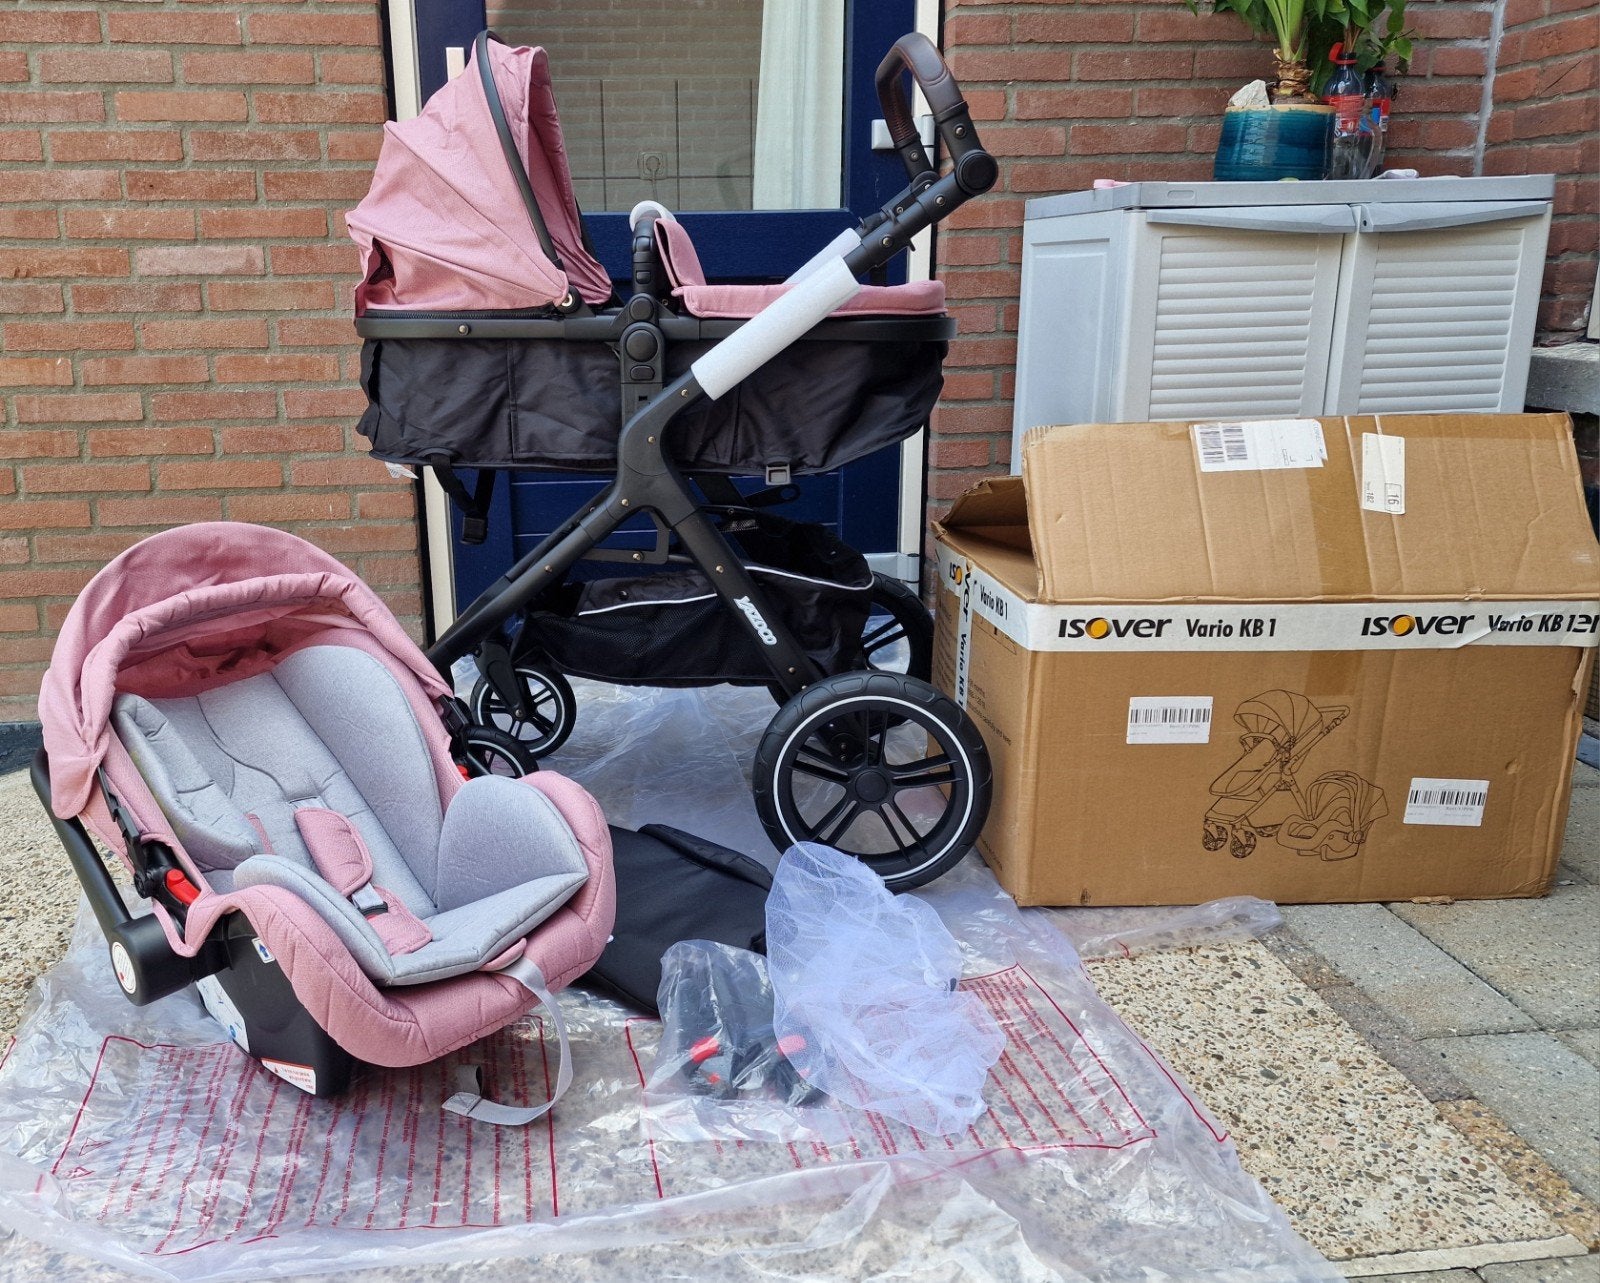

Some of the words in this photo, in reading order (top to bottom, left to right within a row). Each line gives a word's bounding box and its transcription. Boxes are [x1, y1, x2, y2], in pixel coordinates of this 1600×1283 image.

[1387, 494, 1400, 505] 16
[980, 584, 995, 610] Vario
[995, 595, 1004, 617] KB
[1186, 618, 1234, 638] Vario
[1239, 618, 1265, 638] KB
[1269, 618, 1277, 637] 1
[1488, 614, 1534, 632] Vario
[1537, 614, 1564, 632] KB
[959, 633, 967, 671] Vario
